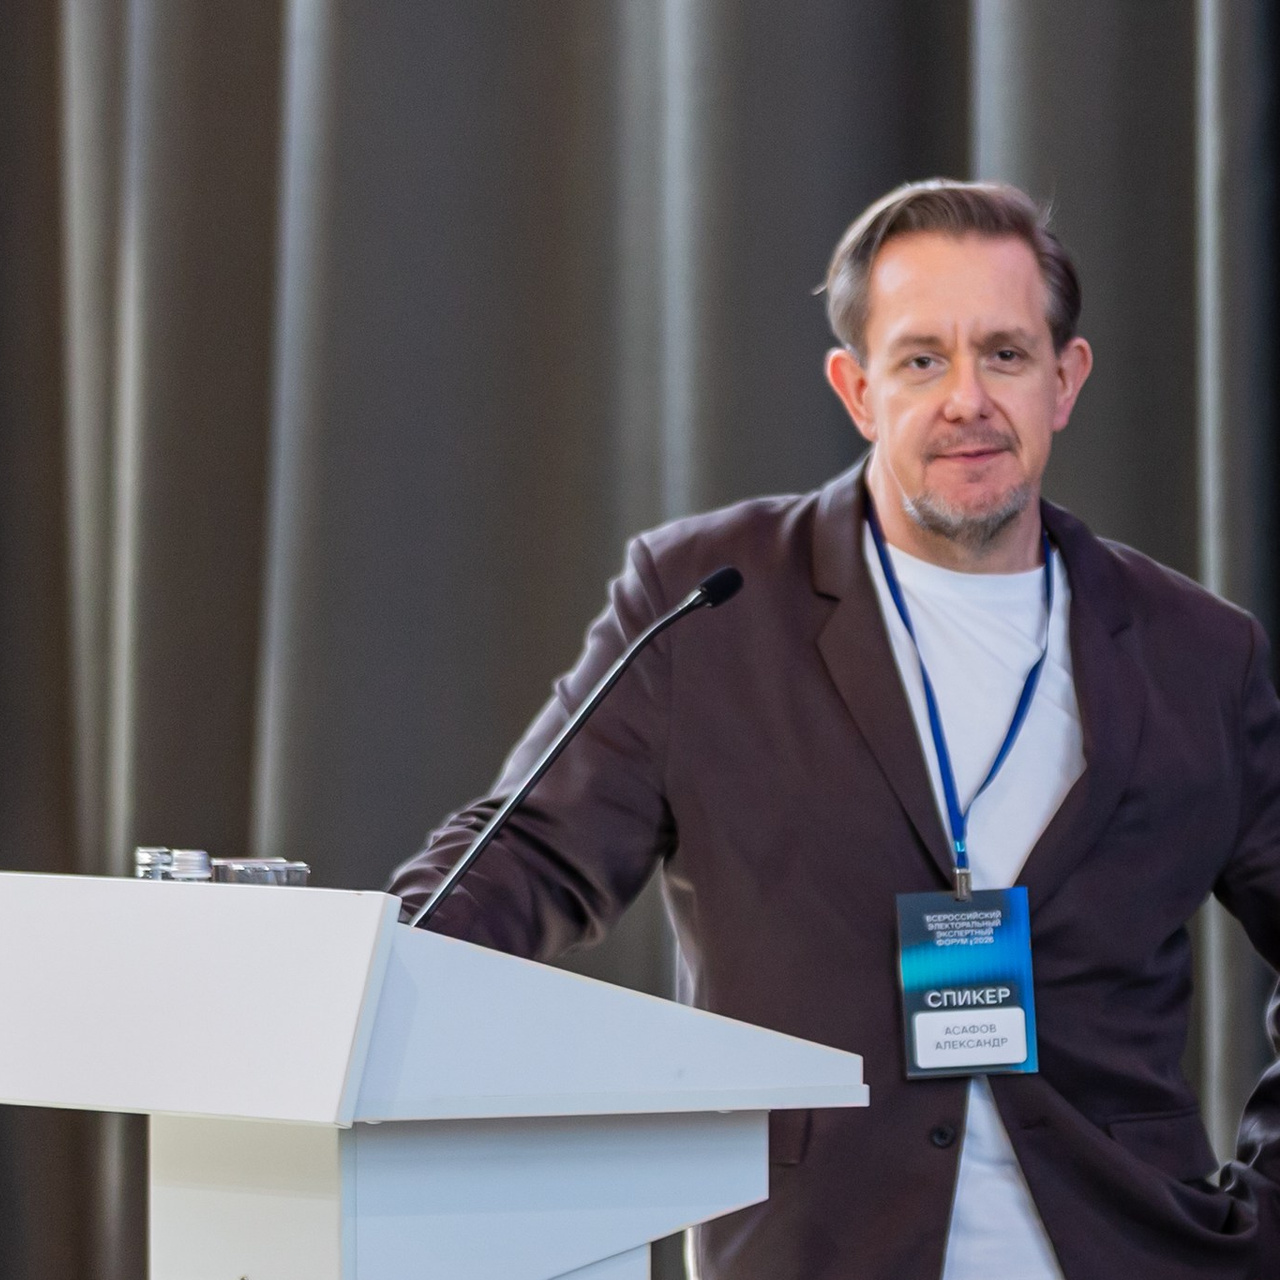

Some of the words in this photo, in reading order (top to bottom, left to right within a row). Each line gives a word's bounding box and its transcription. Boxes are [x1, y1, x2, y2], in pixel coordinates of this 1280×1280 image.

[926, 911, 1001, 921] ВСЕРОССИЙСКИЙ
[928, 919, 1001, 930] ЭЛЕКТОРАЛЬНЫЙ
[936, 928, 993, 938] ЭКСПЕРТНЫЙ
[936, 938, 968, 946] ФОРУМ
[928, 988, 1010, 1008] СПИКЕР
[944, 1024, 997, 1036] АСАФОВ
[935, 1038, 1008, 1050] АЛЕКСАНДР
